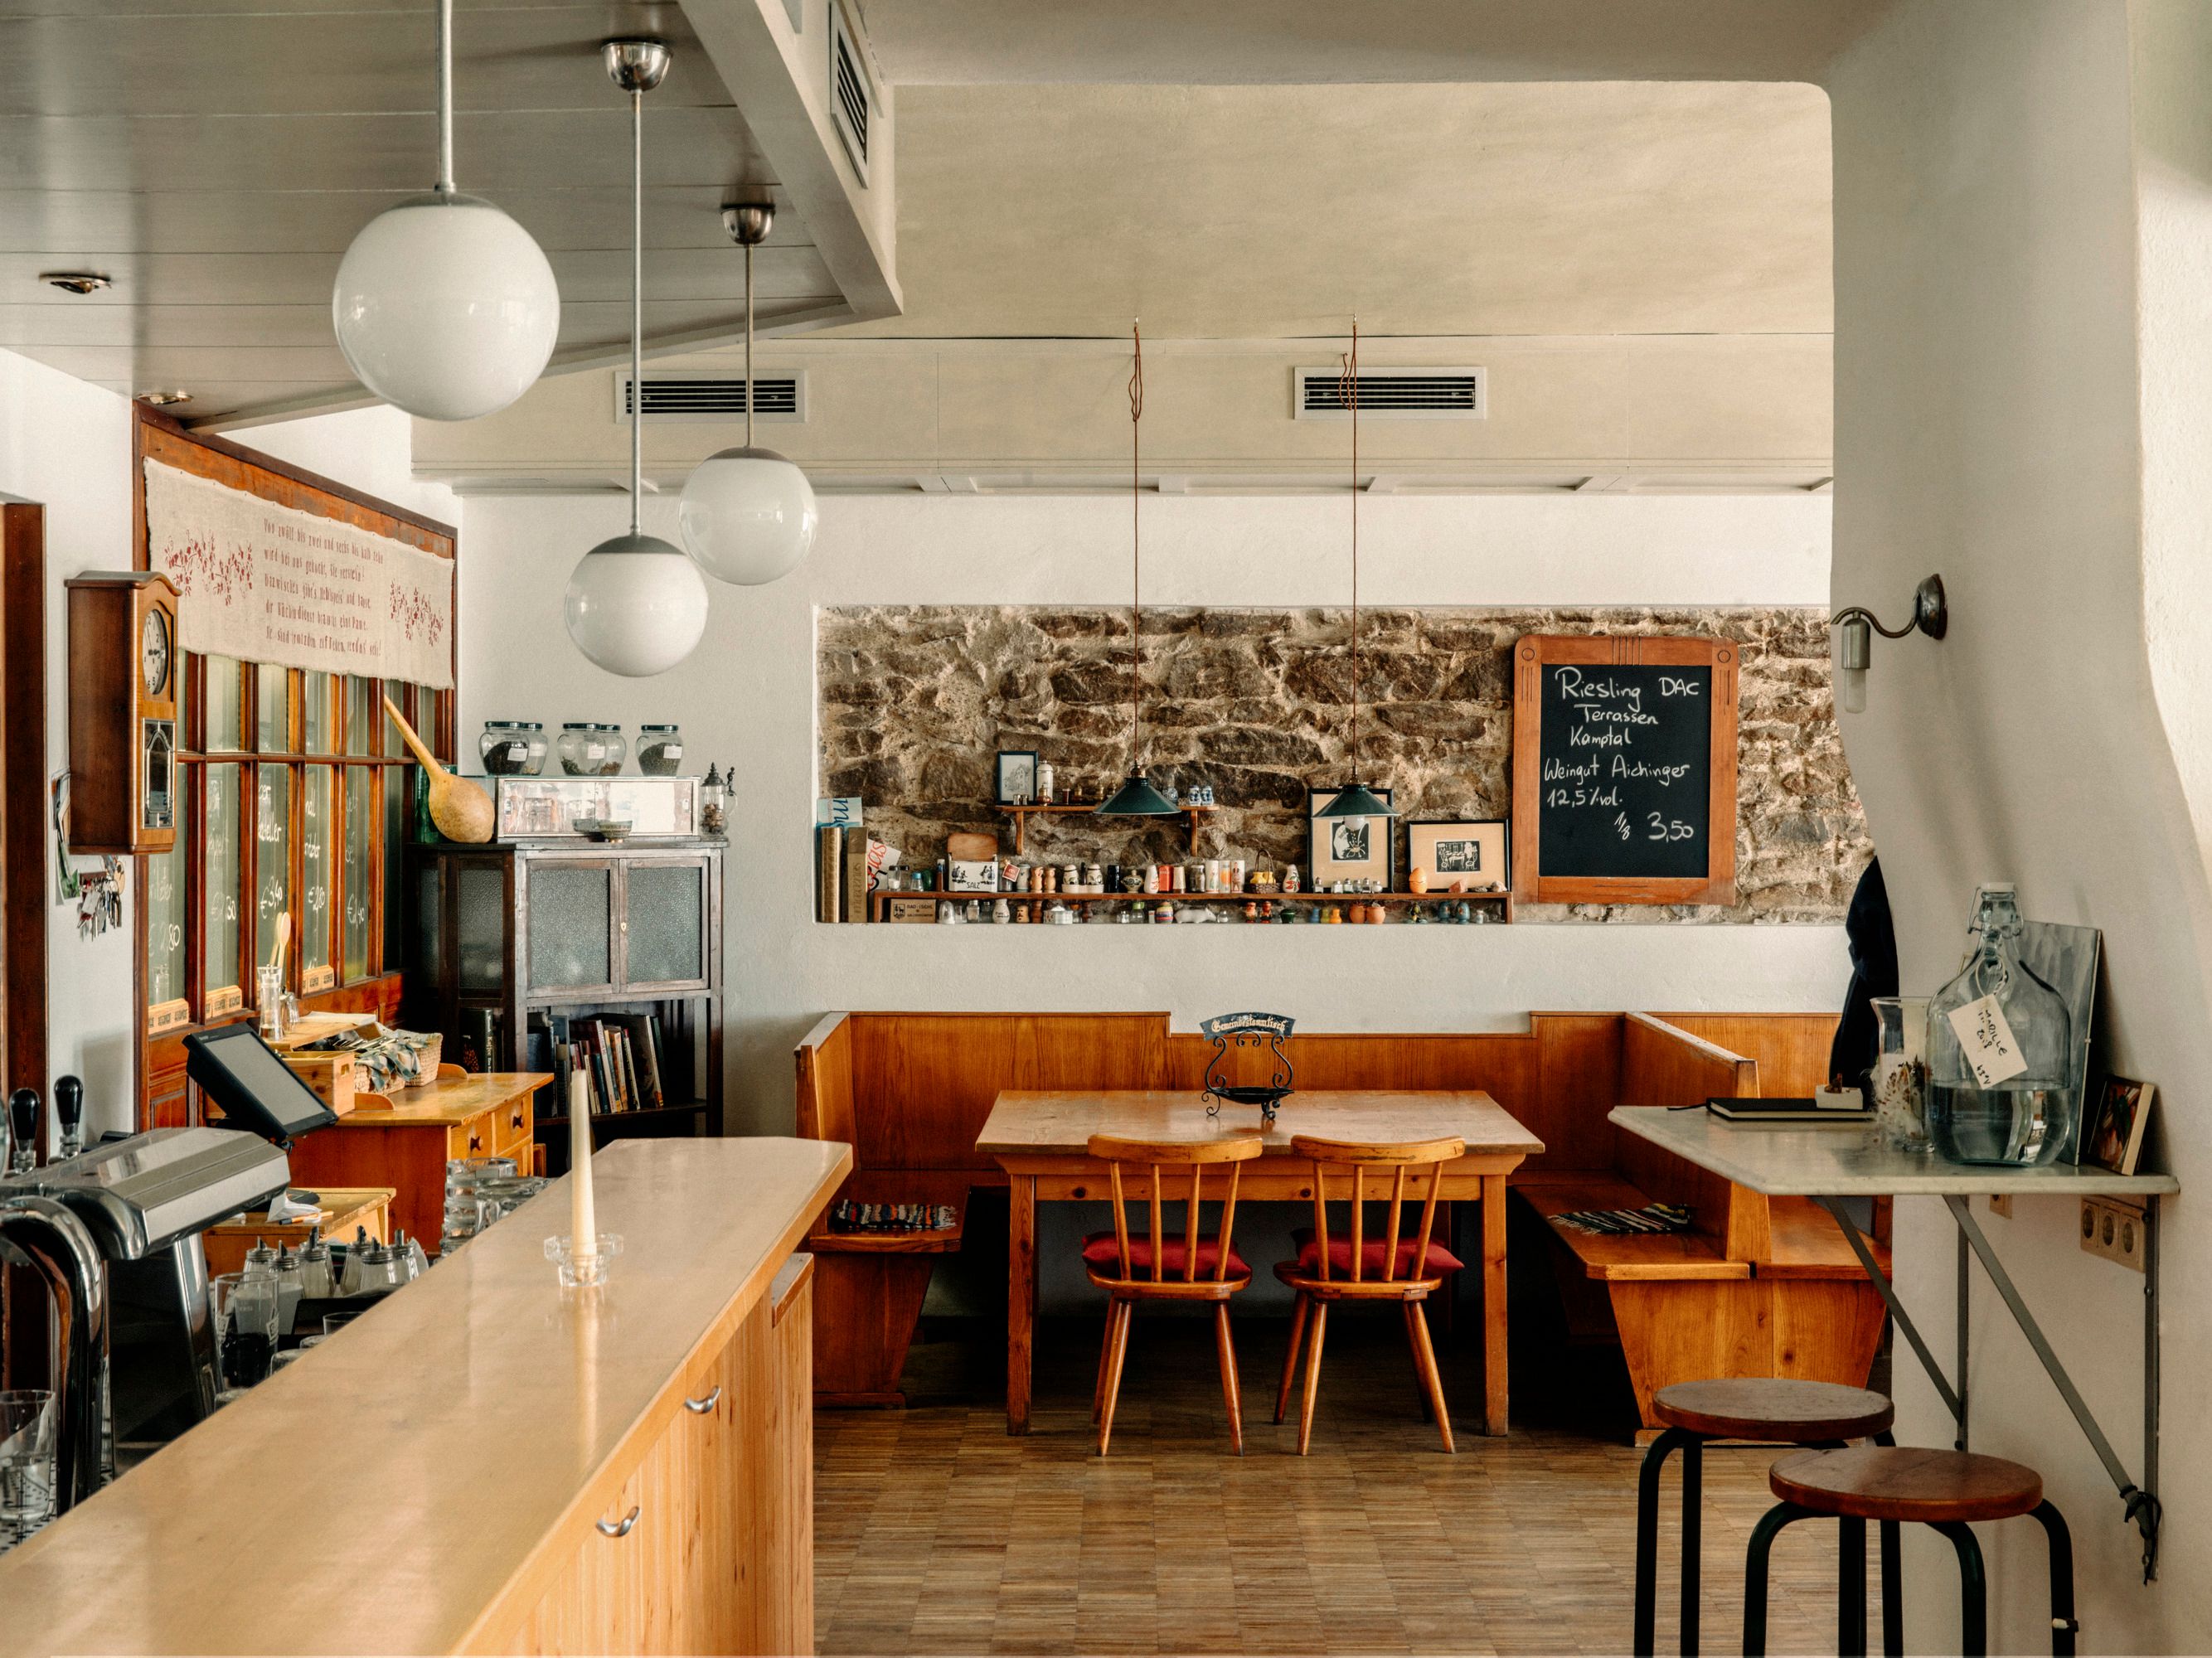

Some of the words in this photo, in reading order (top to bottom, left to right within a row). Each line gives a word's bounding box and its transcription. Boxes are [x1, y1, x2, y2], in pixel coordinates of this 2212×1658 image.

[308, 535, 322, 548] zwei
[1555, 667, 1641, 712] Riesling
[1658, 676, 1700, 697] DAC
[1574, 704, 1659, 725] Terrassen
[1570, 725, 1632, 749] Kamptal
[1545, 754, 1600, 785] Weingut
[1611, 754, 1691, 787] Aichinger
[1646, 811, 1695, 843] 3,50
[967, 881, 981, 890] SALZ
